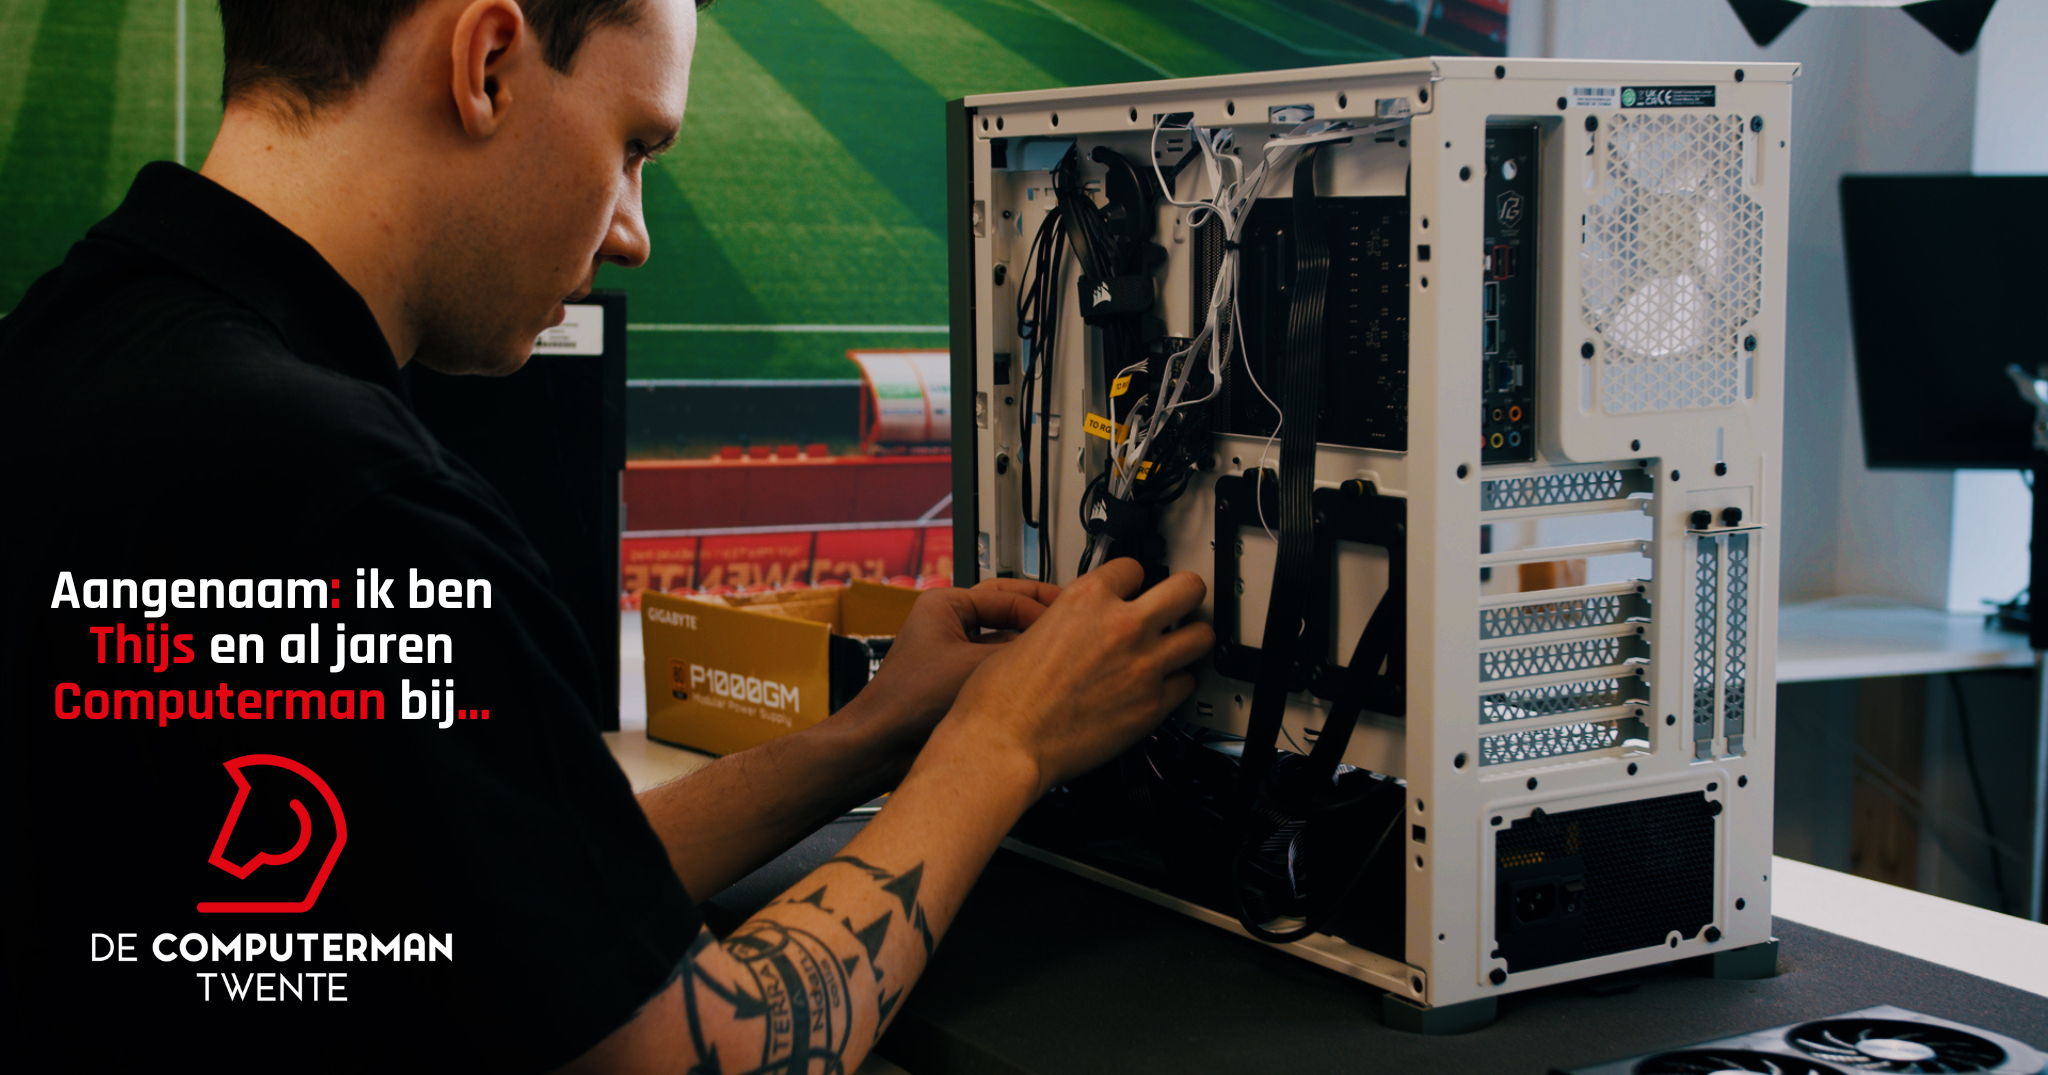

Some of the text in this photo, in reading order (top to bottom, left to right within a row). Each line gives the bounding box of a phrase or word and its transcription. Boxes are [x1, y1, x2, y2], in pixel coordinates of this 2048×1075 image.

[1089, 420, 1100, 429] TO
[648, 607, 698, 631] GIGABYTE
[690, 663, 800, 713] P1000GM
[692, 692, 793, 728] Modular Power Supply
[760, 964, 791, 1056] TERRA
